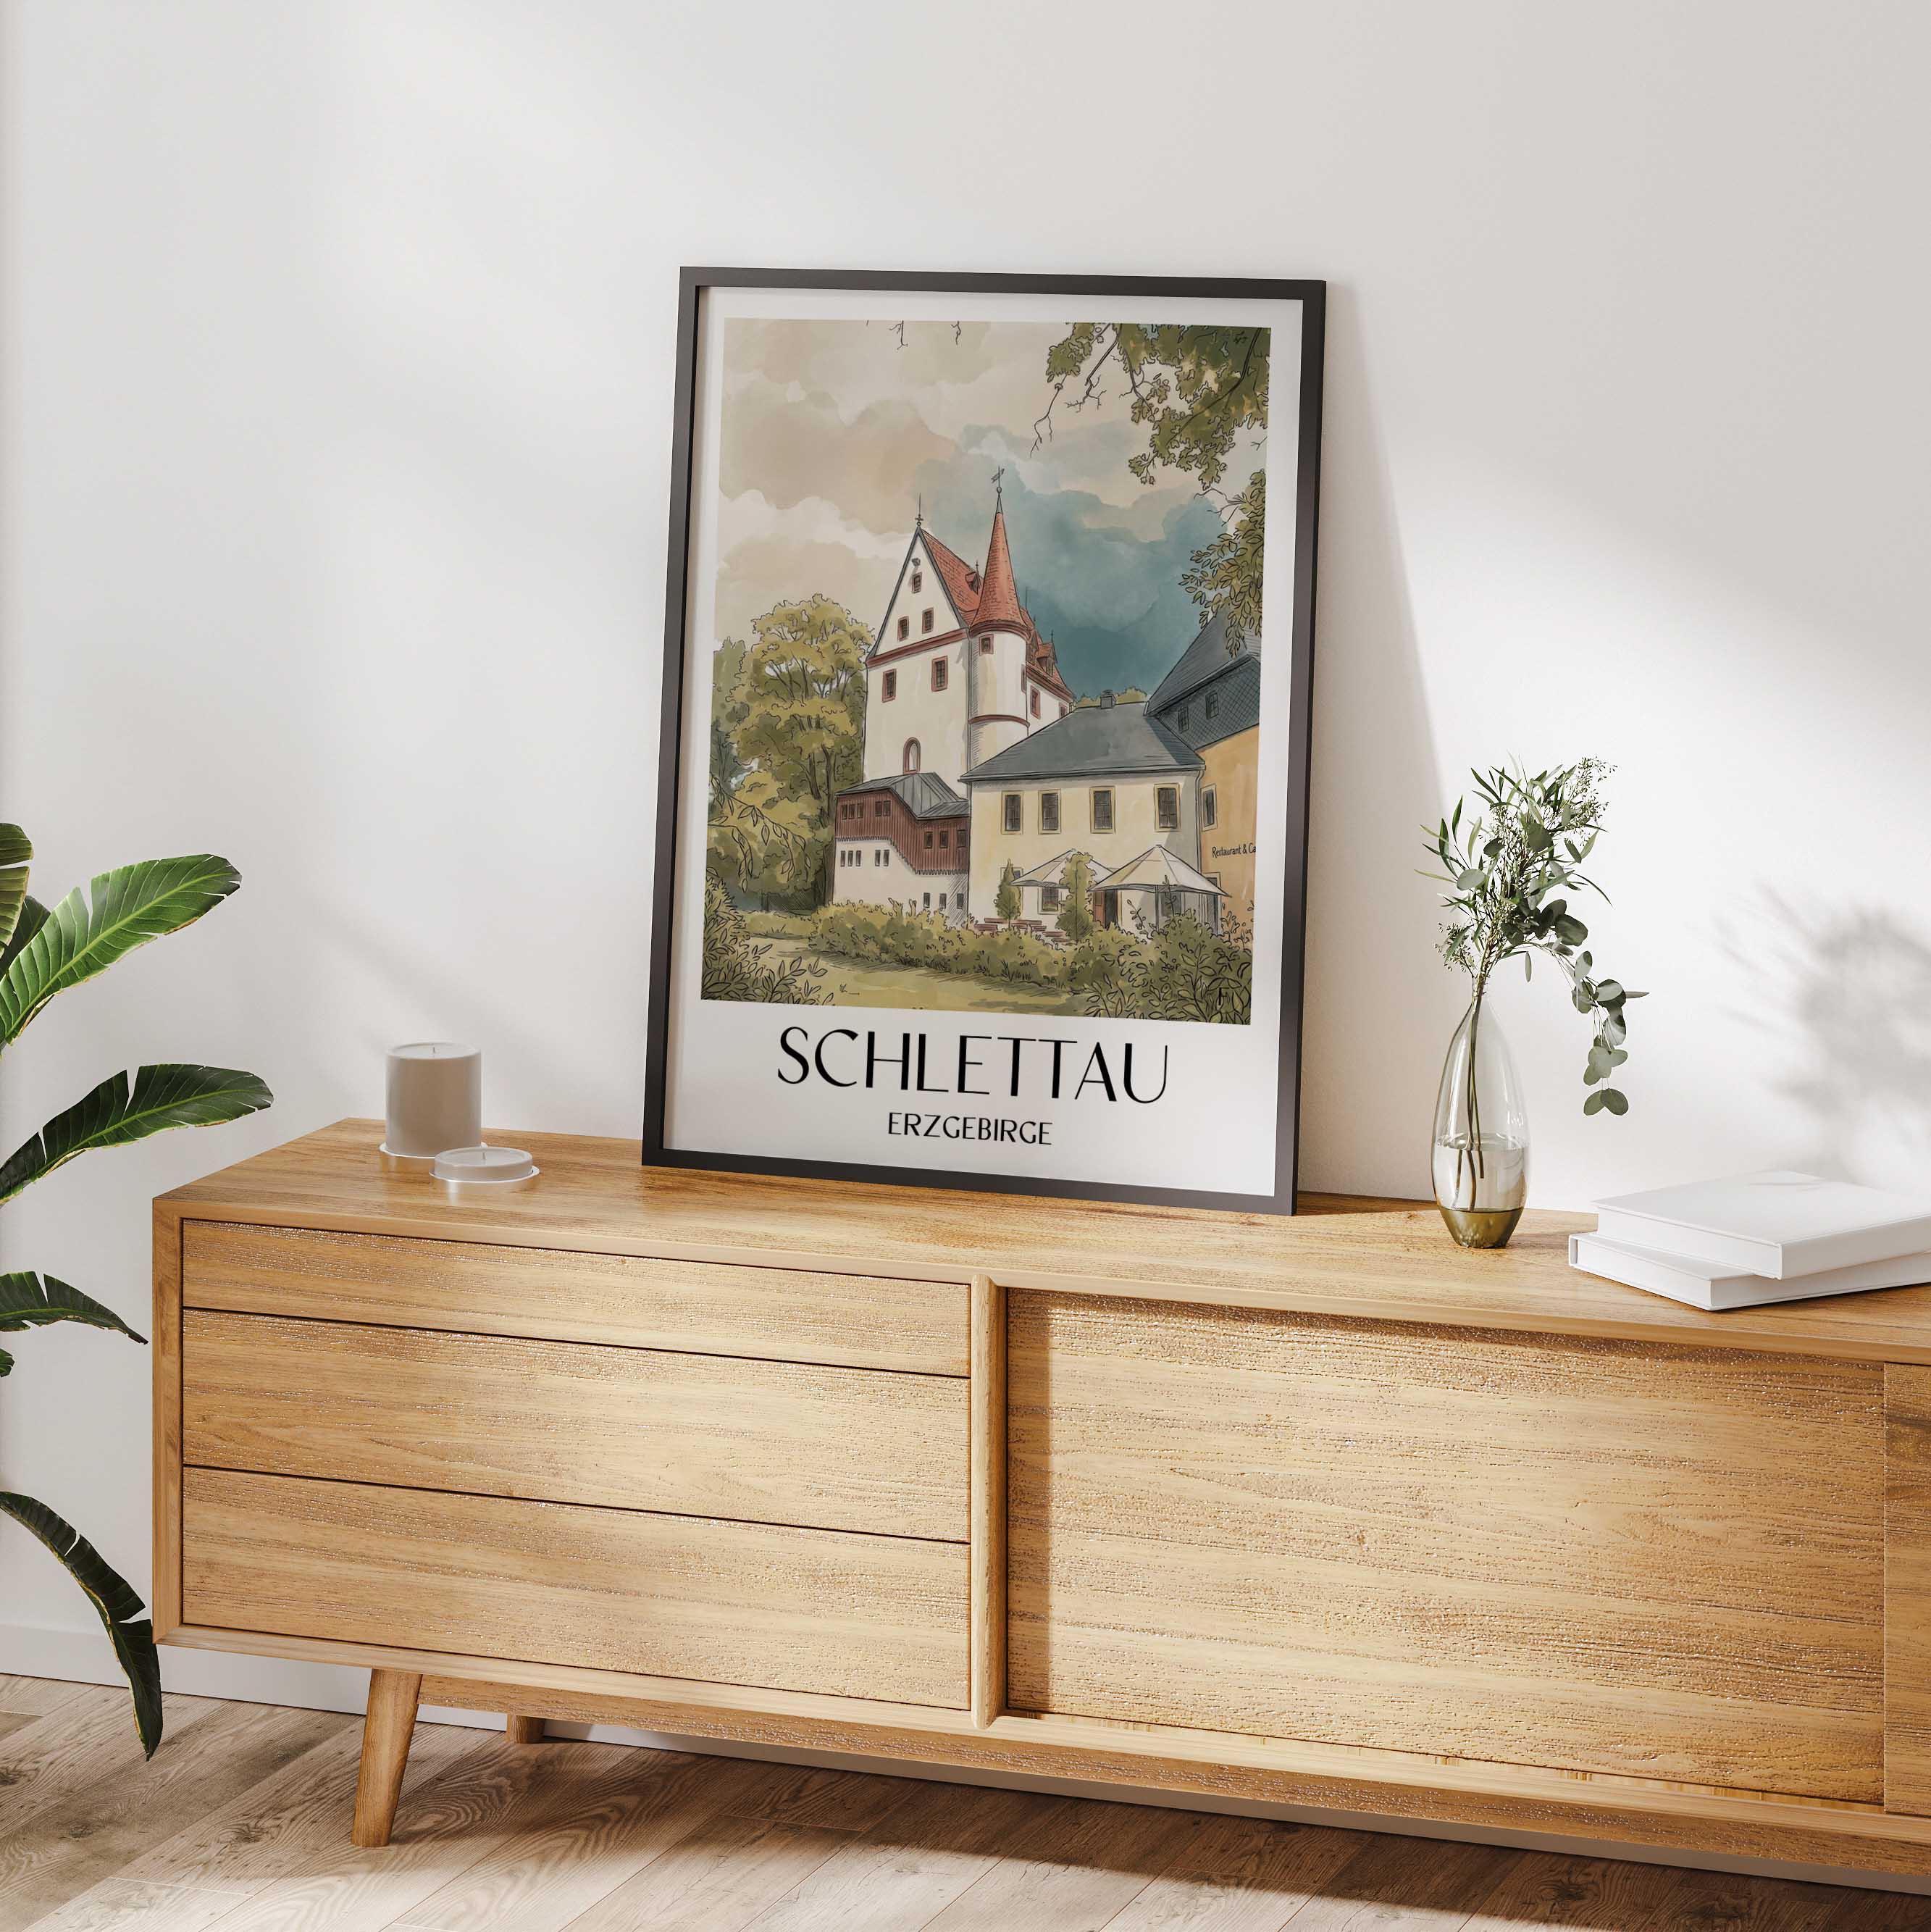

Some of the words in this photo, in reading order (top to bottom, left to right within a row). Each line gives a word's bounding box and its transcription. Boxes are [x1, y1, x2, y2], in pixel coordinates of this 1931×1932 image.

[1243, 844, 1247, 854] &
[777, 1026, 1168, 1103] SCHLETTAU
[888, 1112, 1053, 1145] ERZGEBIRGE
